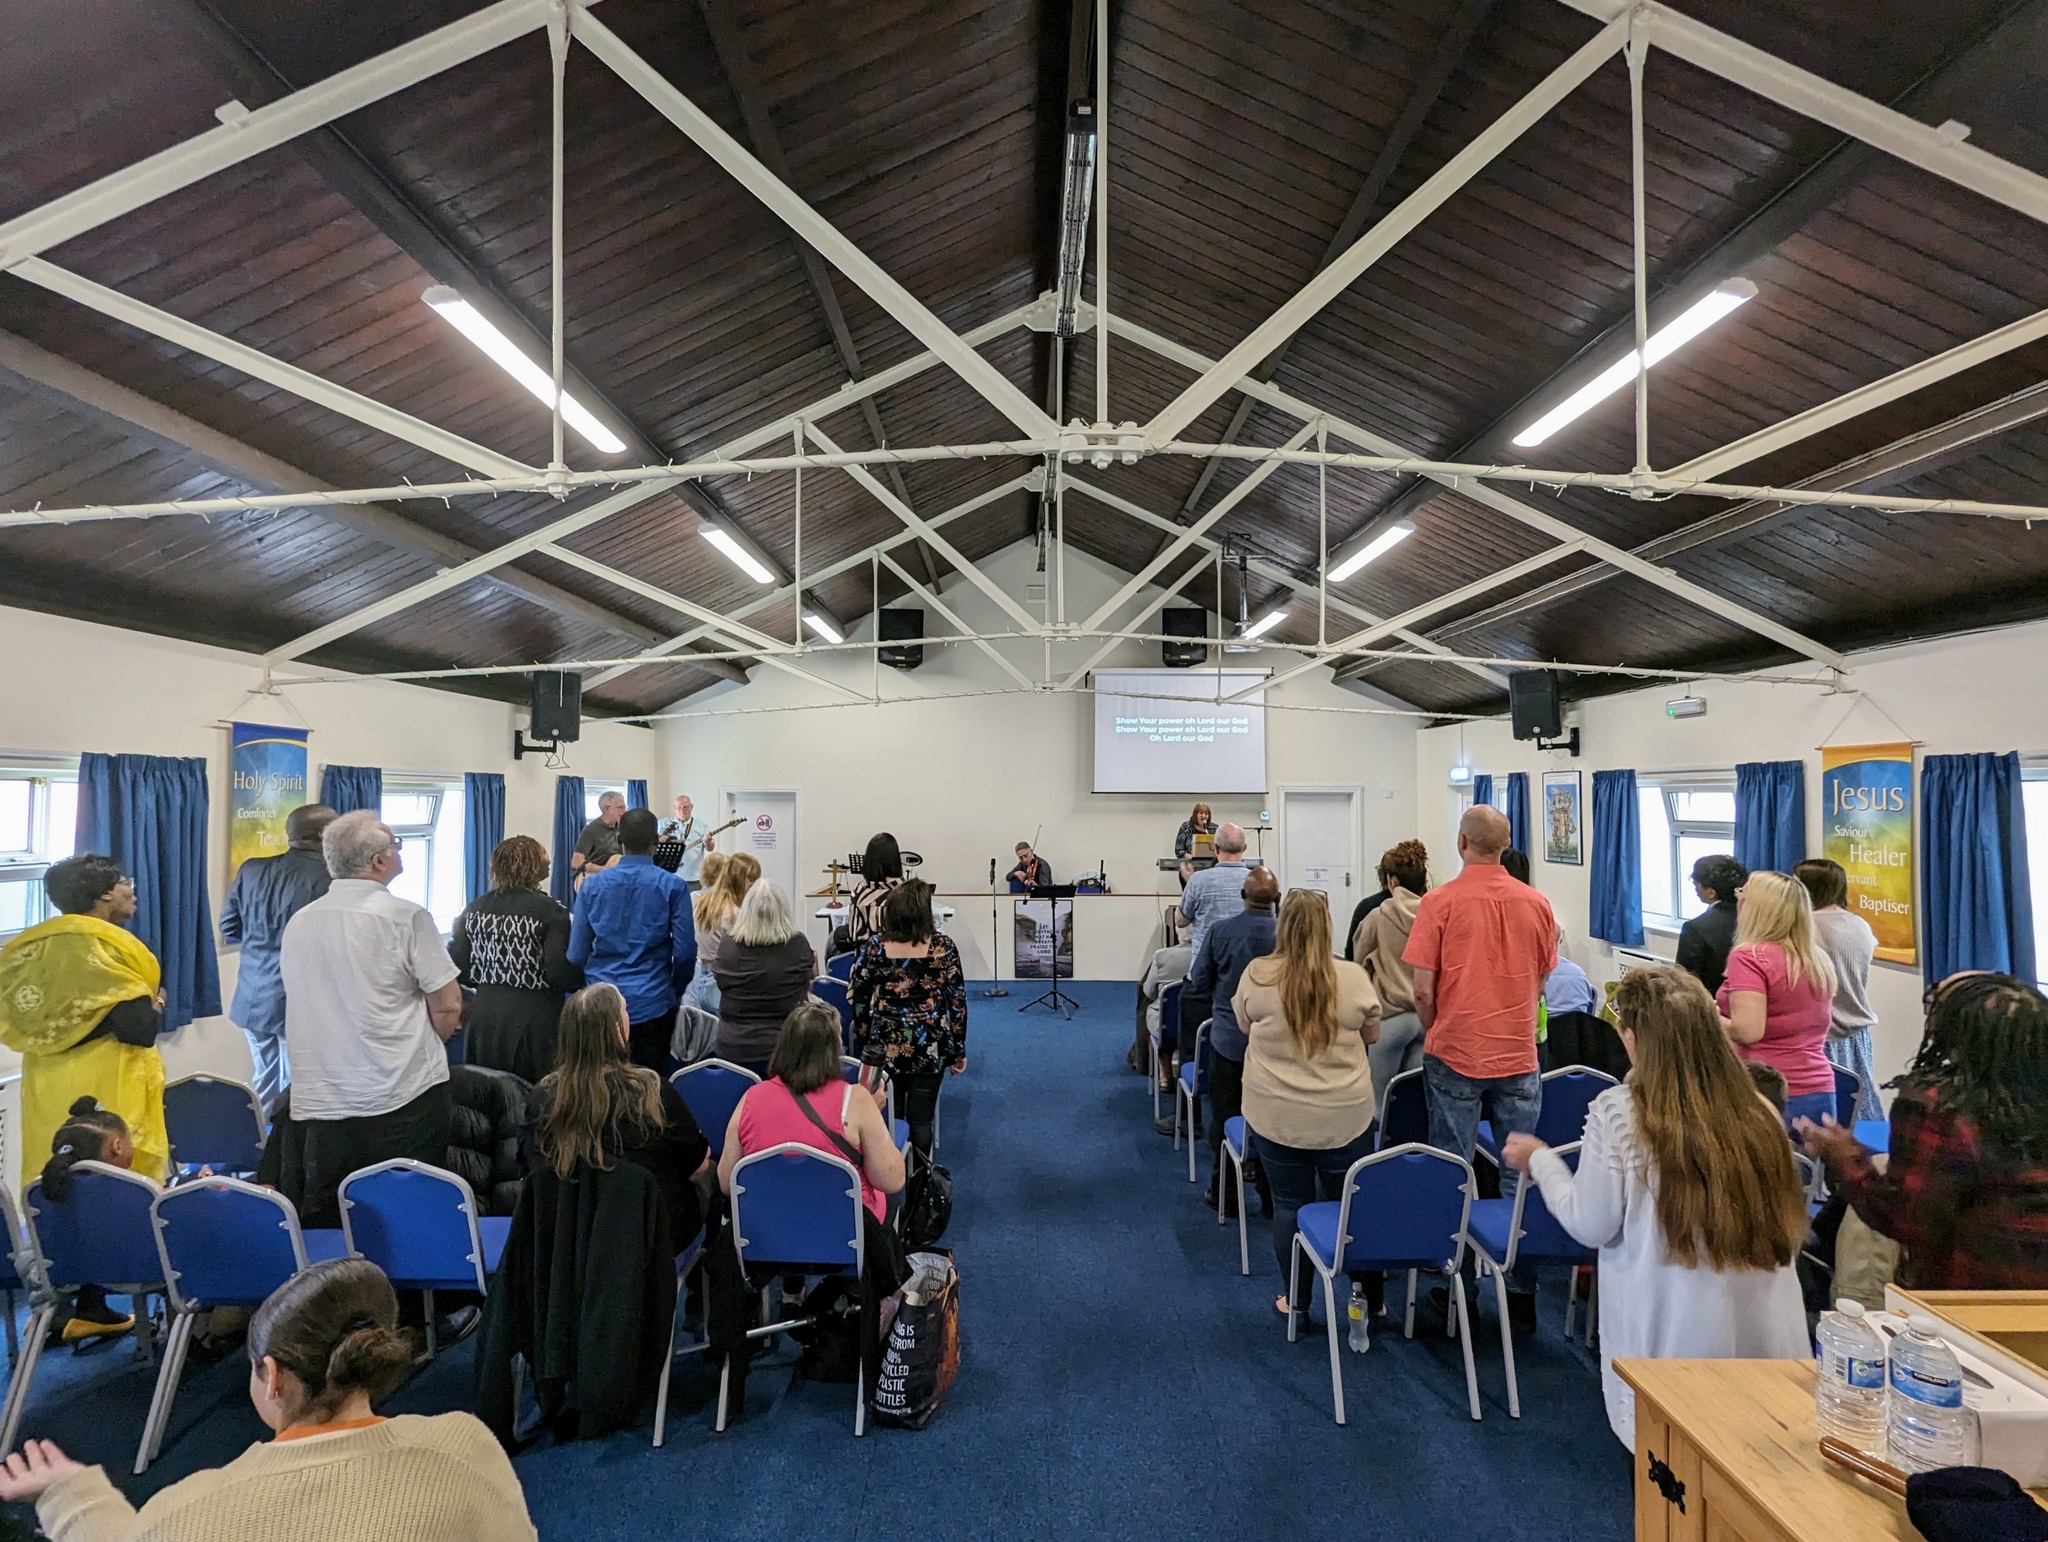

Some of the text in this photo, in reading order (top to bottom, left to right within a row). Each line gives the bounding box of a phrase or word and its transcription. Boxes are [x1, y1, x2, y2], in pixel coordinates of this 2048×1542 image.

[1115, 717, 1138, 725] Show
[1139, 717, 1157, 725] Your
[1158, 718, 1183, 726] power
[1184, 717, 1196, 725] oh
[1197, 717, 1215, 725] Lord
[1231, 717, 1248, 725] God
[1115, 726, 1138, 734] Show
[1139, 726, 1157, 734] Your
[1158, 727, 1183, 735] power
[1184, 726, 1196, 734] oh
[1197, 726, 1215, 734] Lord
[1231, 726, 1248, 734] God
[1149, 734, 1161, 742] Oh
[1163, 734, 1181, 742] Lord
[1197, 734, 1214, 742] God
[233, 770, 304, 797] Holy Spirit
[1833, 779, 1905, 817] Jesus
[237, 807, 277, 819] Comforter
[1834, 825, 1869, 838] Saviour
[257, 830, 289, 847] Teach
[1850, 844, 1907, 867] Healer
[1846, 875, 1877, 886] ervant
[1859, 894, 1910, 916] Baptiser
[906, 1325, 915, 1336] IS
[893, 1338, 915, 1350] FROM
[887, 1349, 902, 1364] 00%
[878, 1374, 905, 1391] PLASTIC
